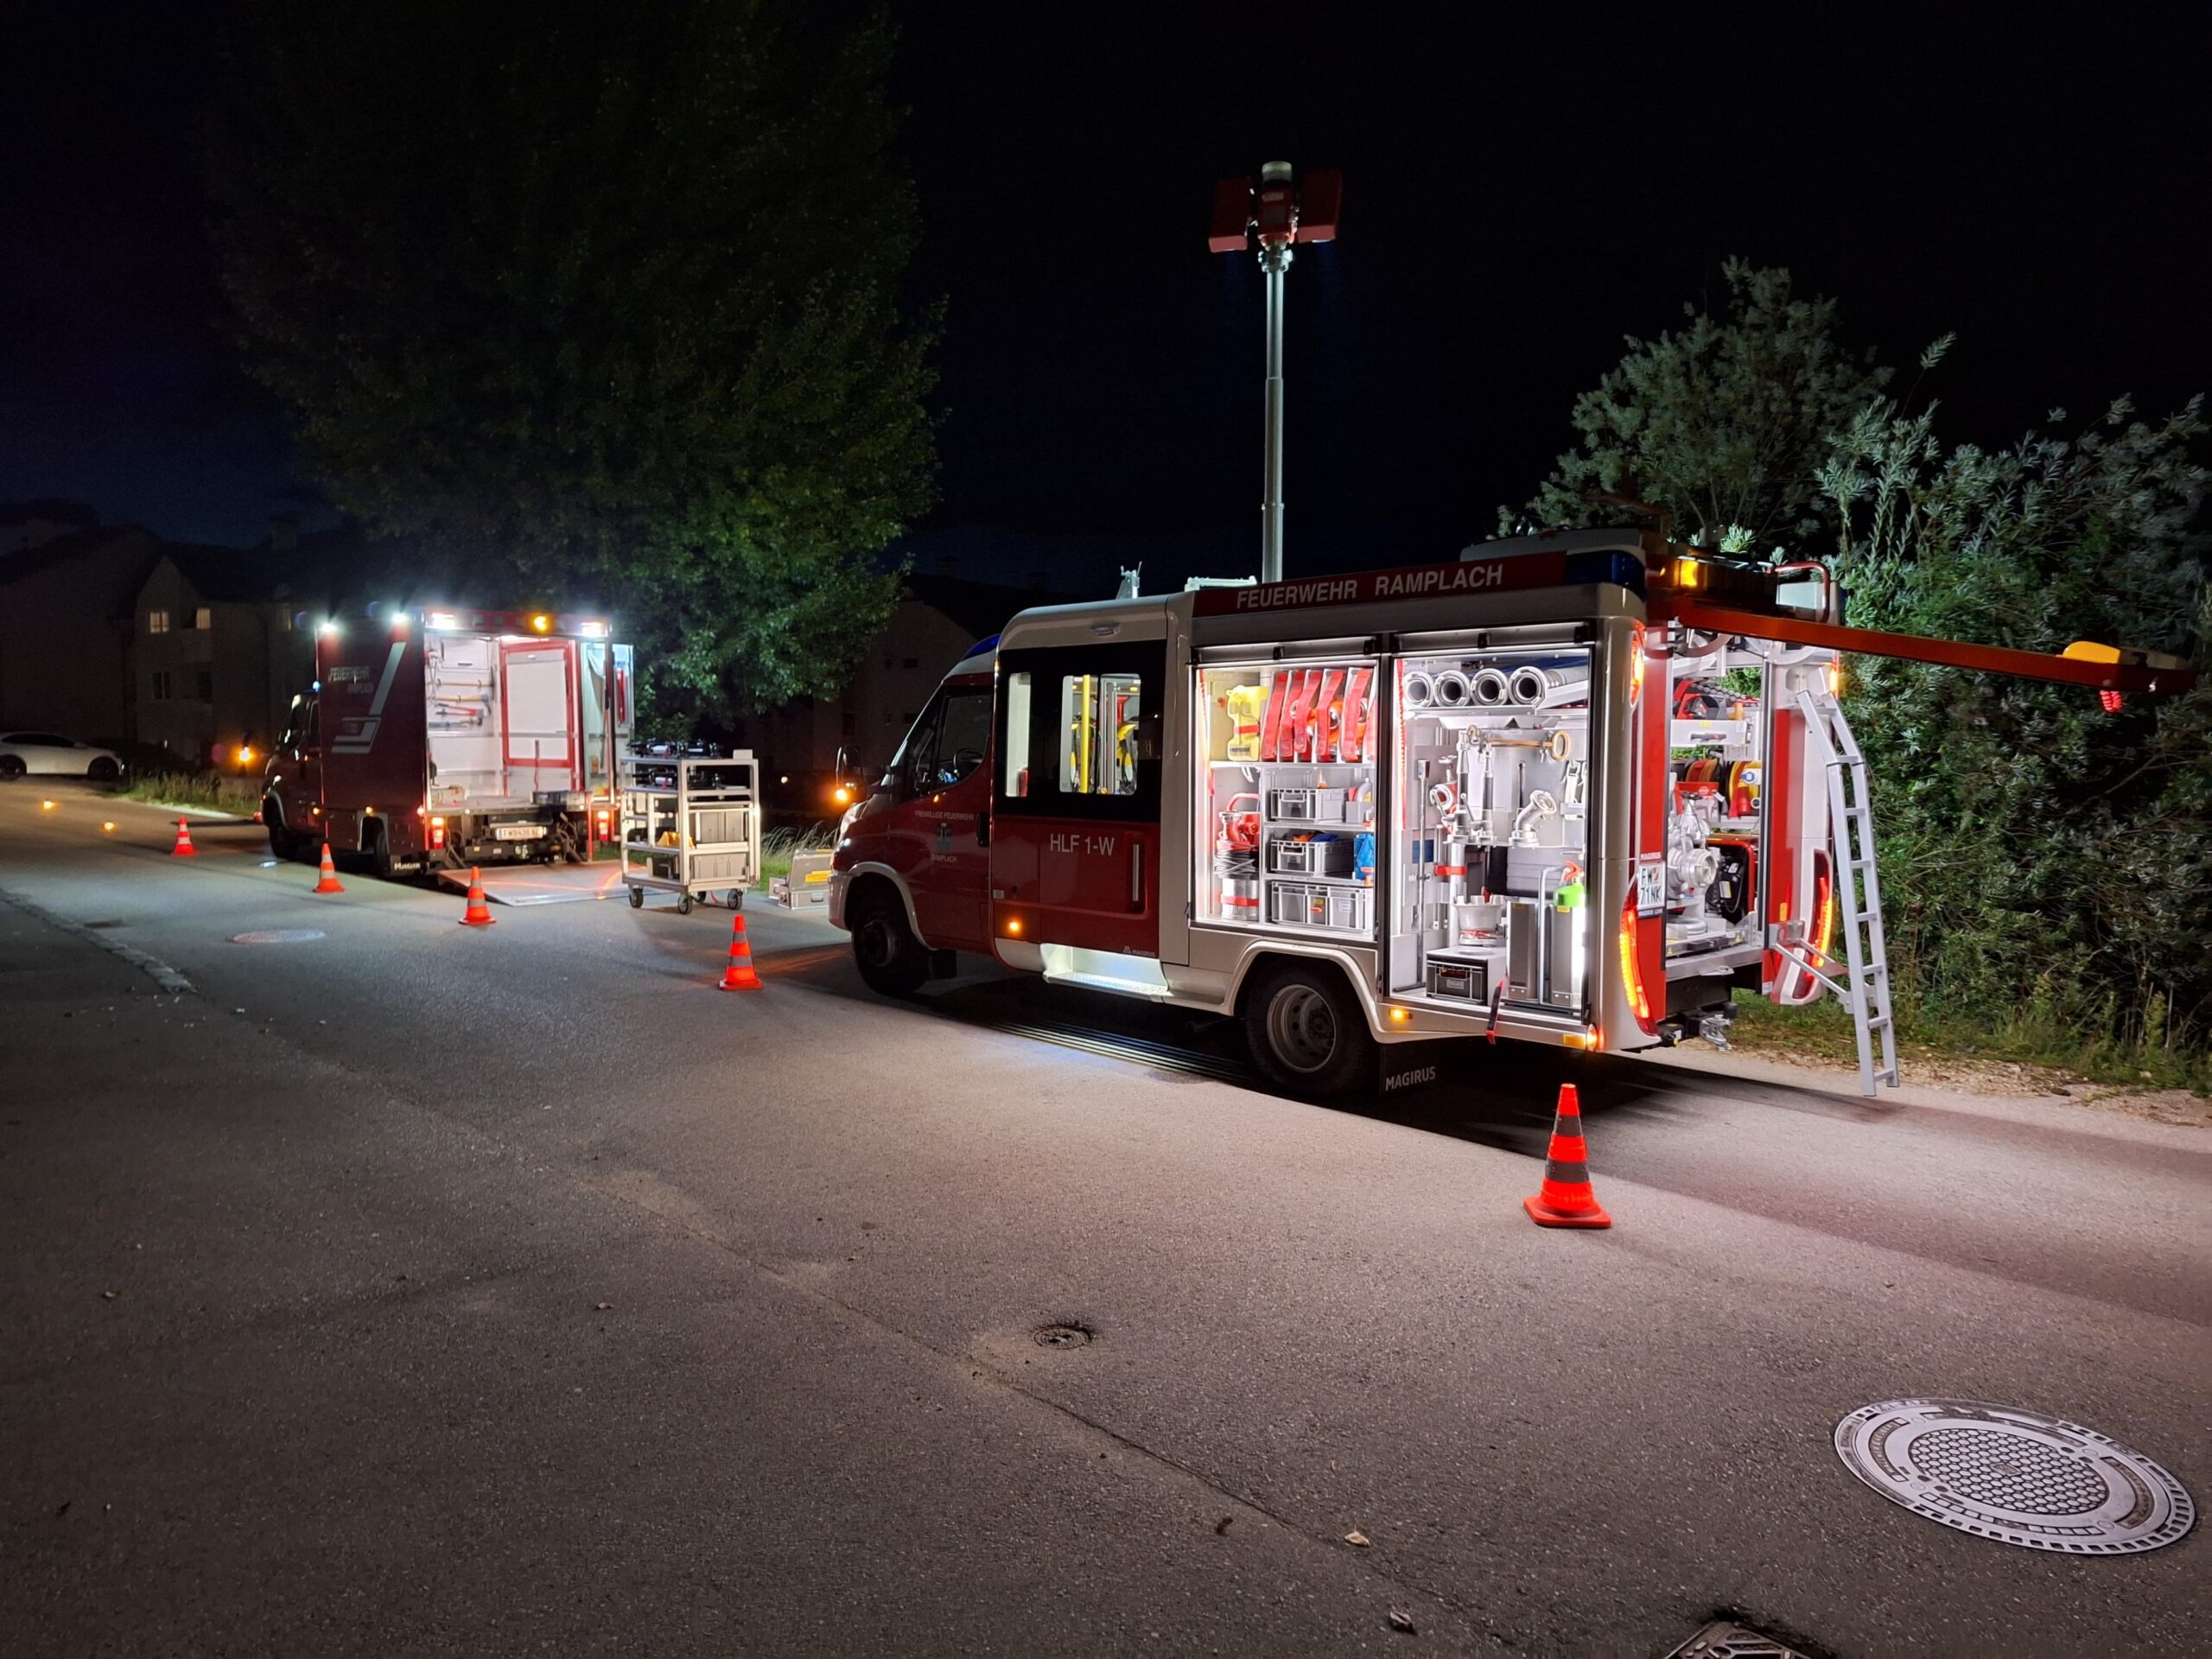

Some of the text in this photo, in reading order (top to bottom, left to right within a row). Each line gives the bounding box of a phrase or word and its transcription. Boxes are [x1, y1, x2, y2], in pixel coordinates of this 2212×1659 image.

[1236, 563, 1503, 608] FEUERWEHR RAMPLACH
[1050, 833, 1115, 856] HLF 1-W
[1641, 867, 1652, 886] FW
[1385, 1065, 1436, 1091] MAGIRUS
